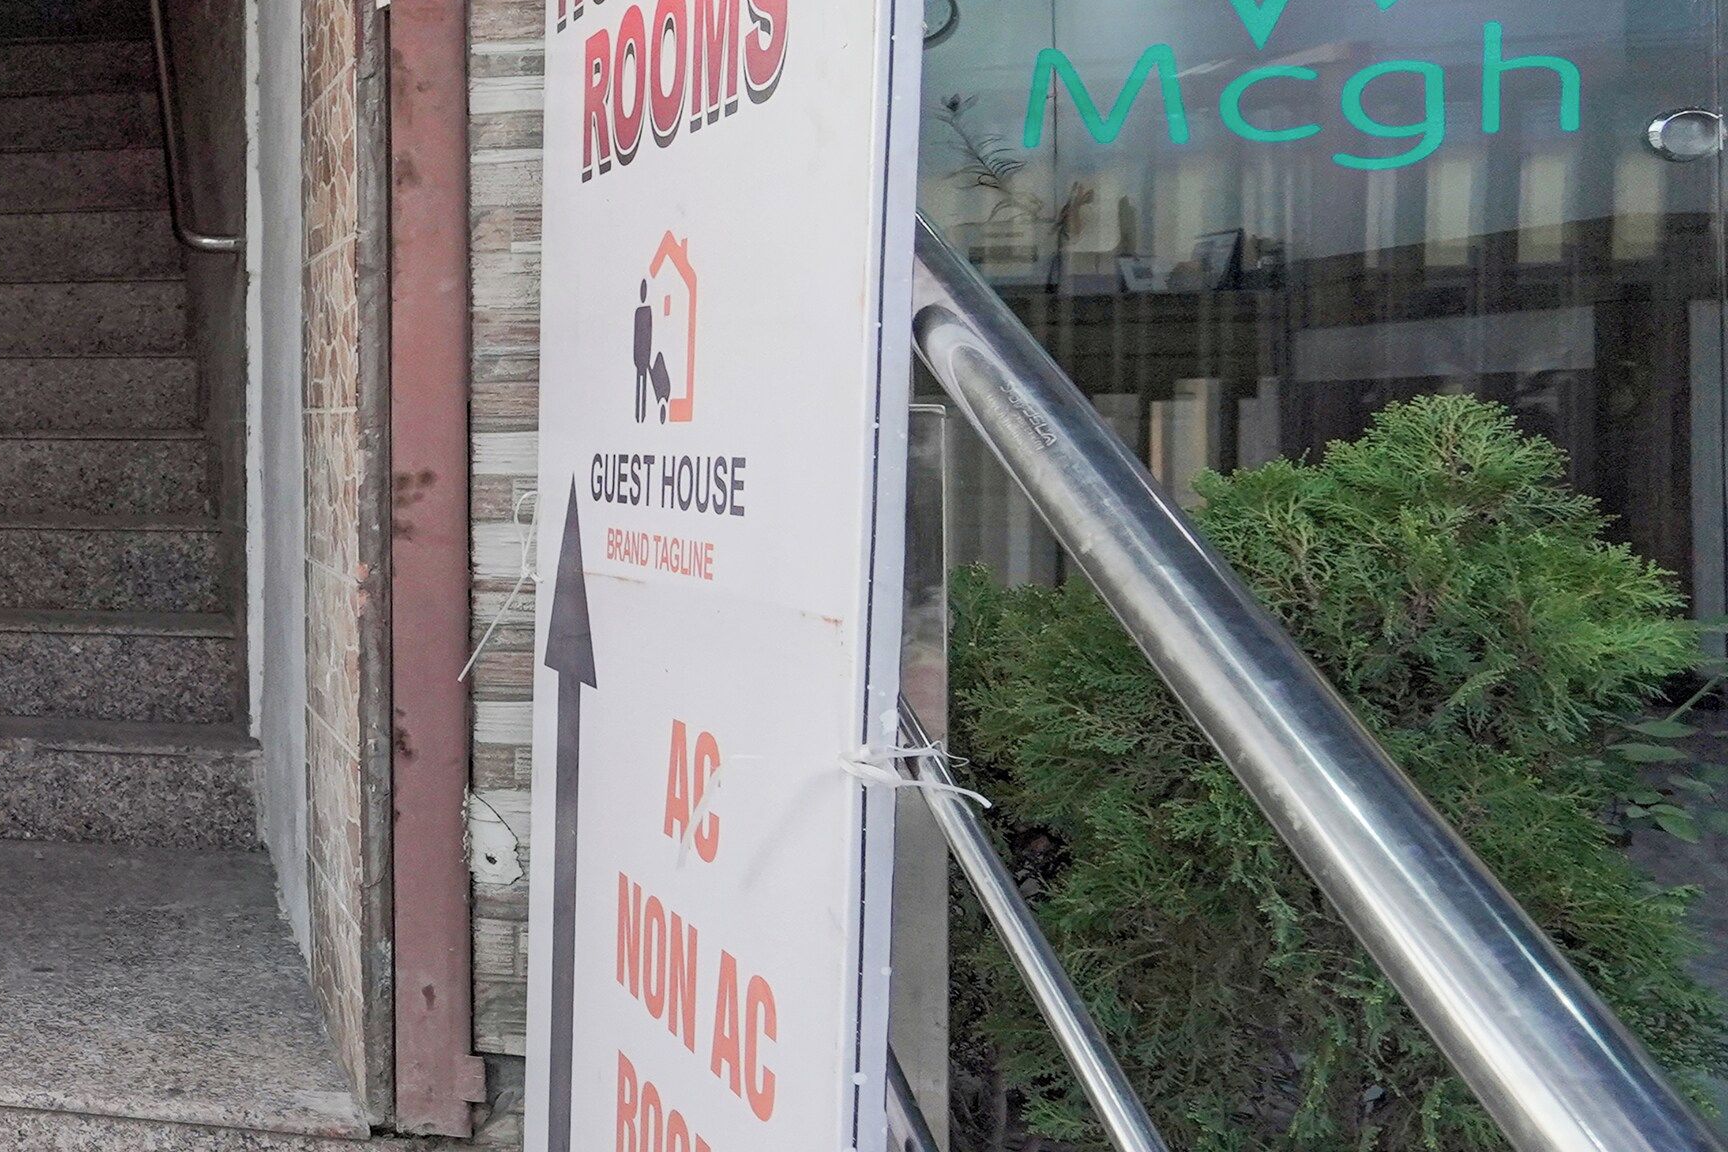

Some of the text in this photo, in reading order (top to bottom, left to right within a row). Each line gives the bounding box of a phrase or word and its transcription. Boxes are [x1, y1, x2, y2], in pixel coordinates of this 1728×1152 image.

[1022, 21, 1581, 170] Mcgh
[590, 453, 747, 517] GUEST HOUSE
[606, 527, 715, 580] BRAND TAGLINE
[663, 718, 721, 863] AC
[616, 871, 777, 1122] NON AC
[615, 1049, 712, 1152] RO
